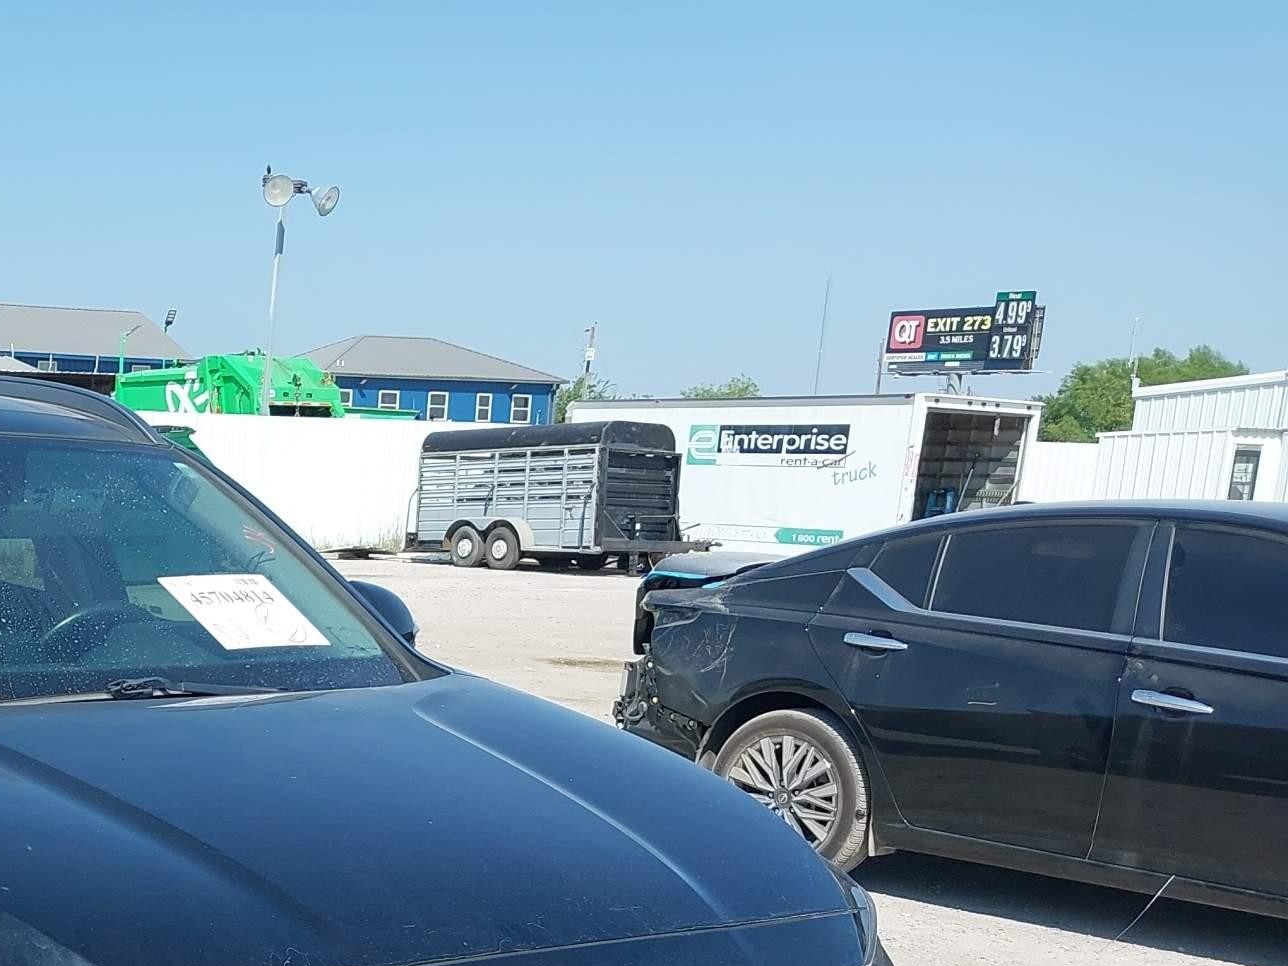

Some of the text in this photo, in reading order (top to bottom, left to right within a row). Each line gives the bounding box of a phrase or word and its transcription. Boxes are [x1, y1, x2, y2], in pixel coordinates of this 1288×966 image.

[926, 315, 992, 332] EXIT 273
[894, 320, 920, 345] QT
[939, 335, 974, 344] 3.5 MILES
[719, 427, 848, 453] Enterprise
[831, 461, 878, 486] truck
[798, 534, 816, 543] 800
[189, 589, 275, 606] 45704814
